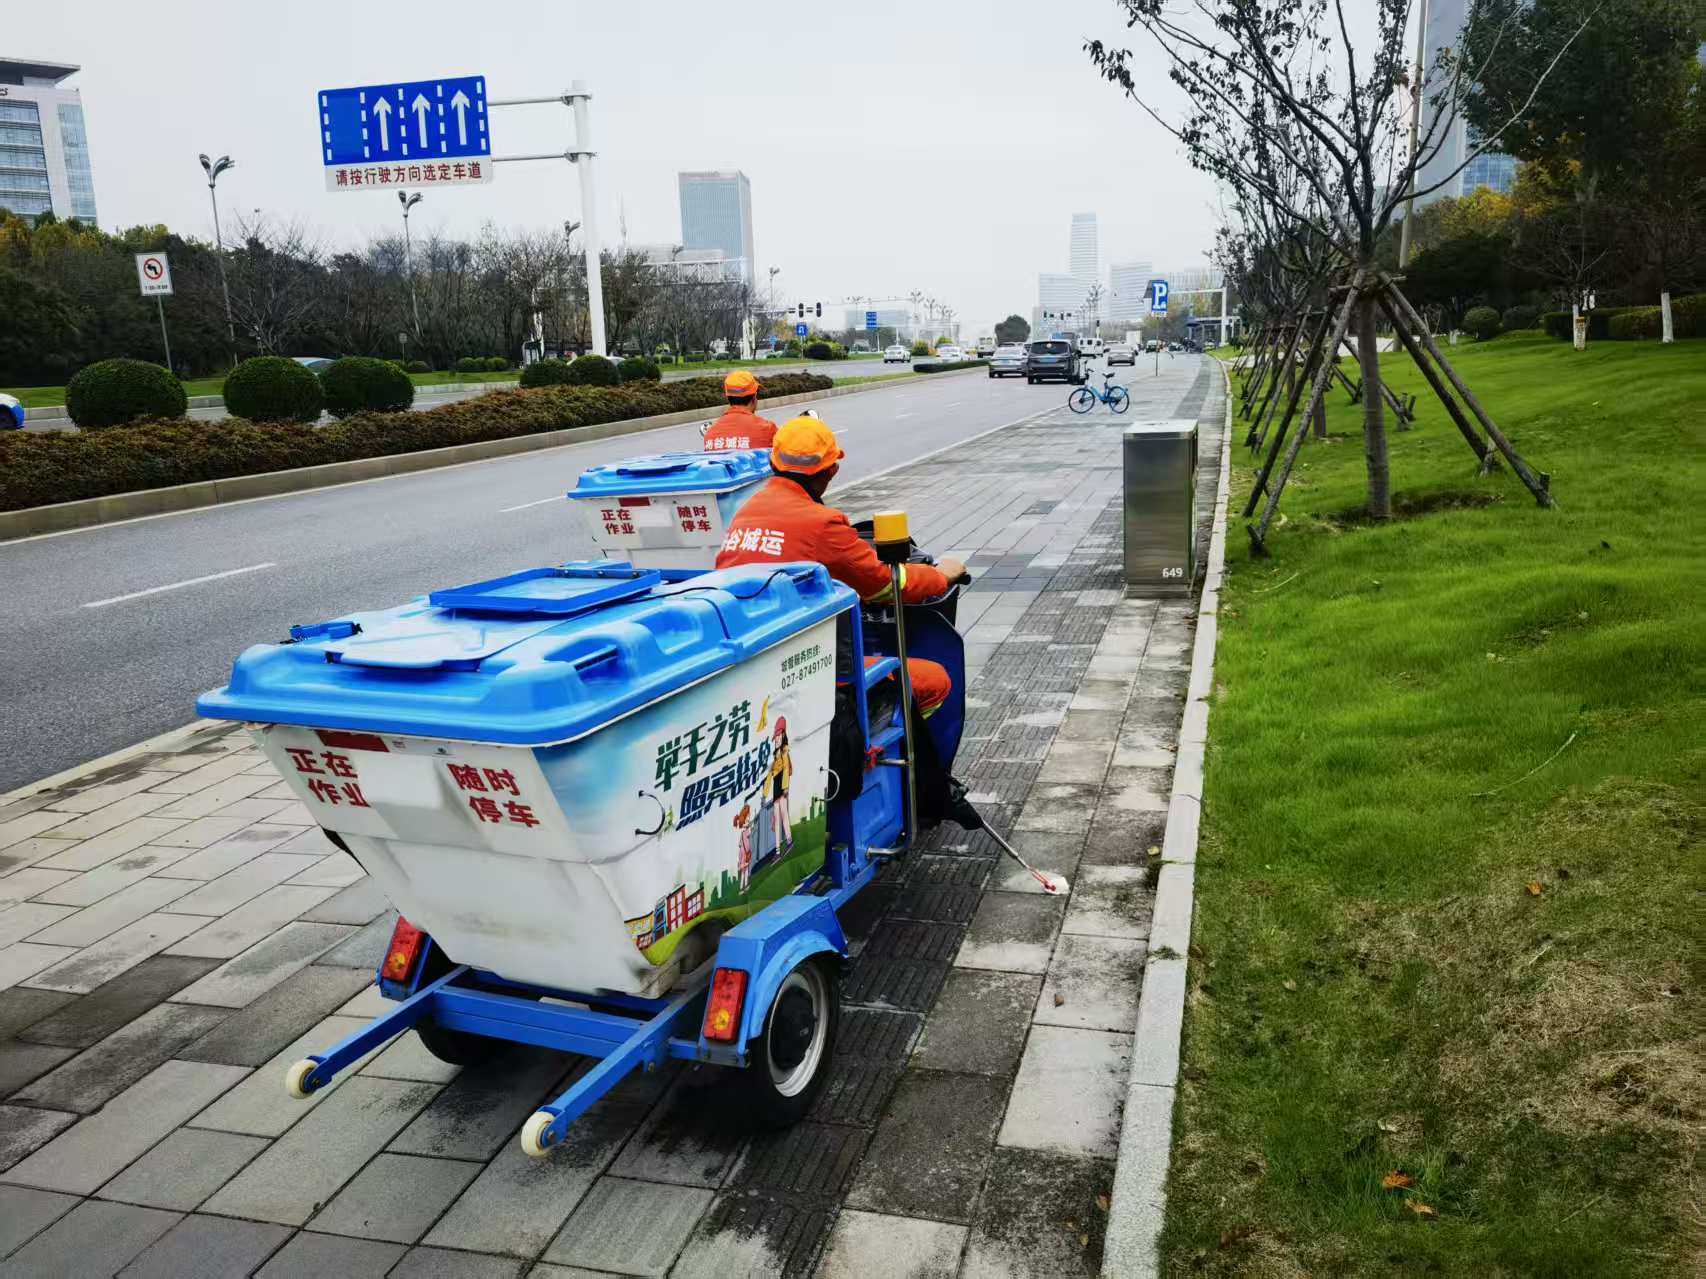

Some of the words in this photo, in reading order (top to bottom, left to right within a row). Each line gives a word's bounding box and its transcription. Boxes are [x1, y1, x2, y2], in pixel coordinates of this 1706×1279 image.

[335, 162, 482, 187] 请按行驶方向选定车道
[1153, 283, 1167, 309] P
[601, 509, 631, 521] 正在
[676, 506, 708, 518] 随时
[605, 523, 635, 535] 作业
[681, 519, 712, 532] 停车
[1162, 567, 1184, 578] 649
[654, 700, 751, 792] 举手之劳
[285, 748, 358, 779] 正在
[446, 763, 521, 796] 随时
[307, 778, 371, 808] 作业
[468, 796, 541, 828] 停车
